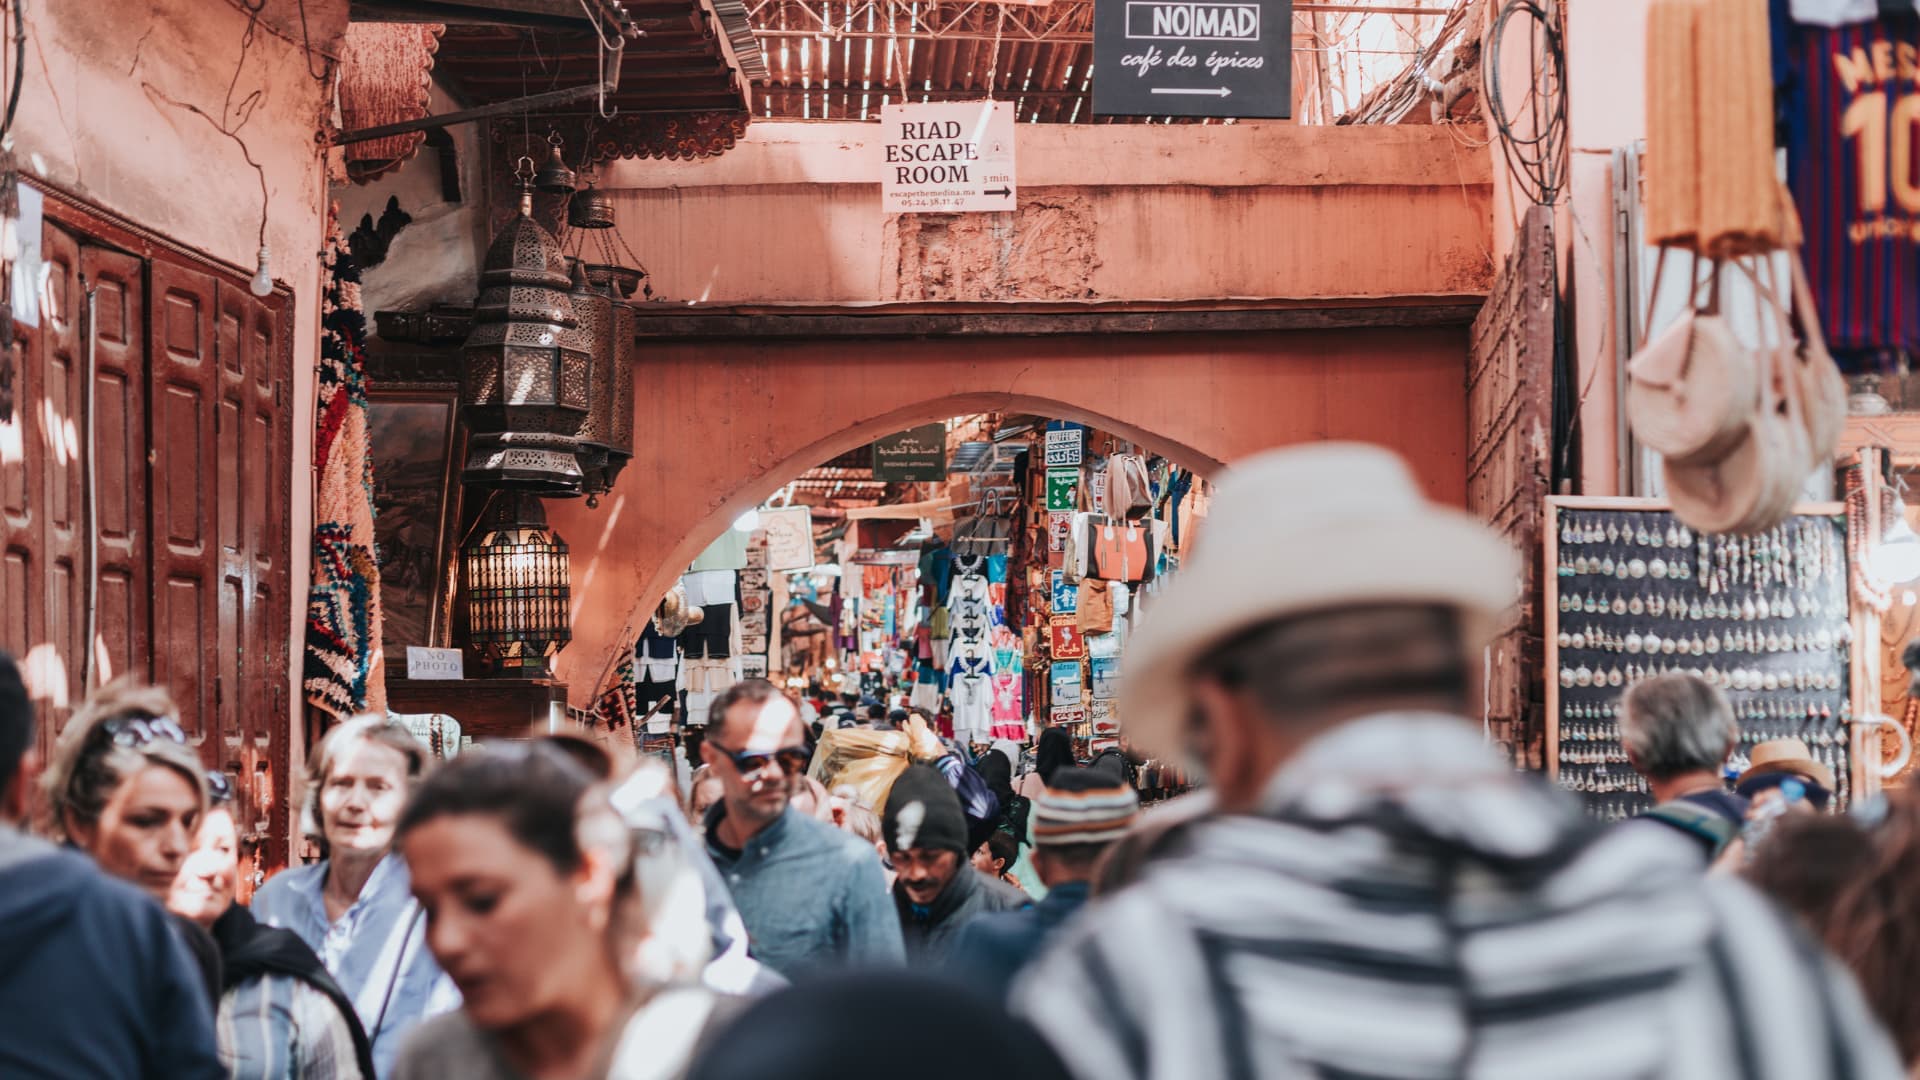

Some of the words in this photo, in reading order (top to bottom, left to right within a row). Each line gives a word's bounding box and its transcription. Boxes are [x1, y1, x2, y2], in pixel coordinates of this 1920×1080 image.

[1120, 45, 1162, 77] café
[1166, 46, 1197, 67] des
[1205, 51, 1264, 76] épices
[1832, 41, 1920, 92] MES
[901, 121, 961, 140] RIAD
[885, 143, 979, 162] ESCAPE
[896, 165, 969, 184] ROOM
[989, 173, 1009, 183] min
[889, 189, 976, 198] escapethemedina.ma
[427, 651, 445, 661] NO
[415, 661, 458, 671] PHOTO
